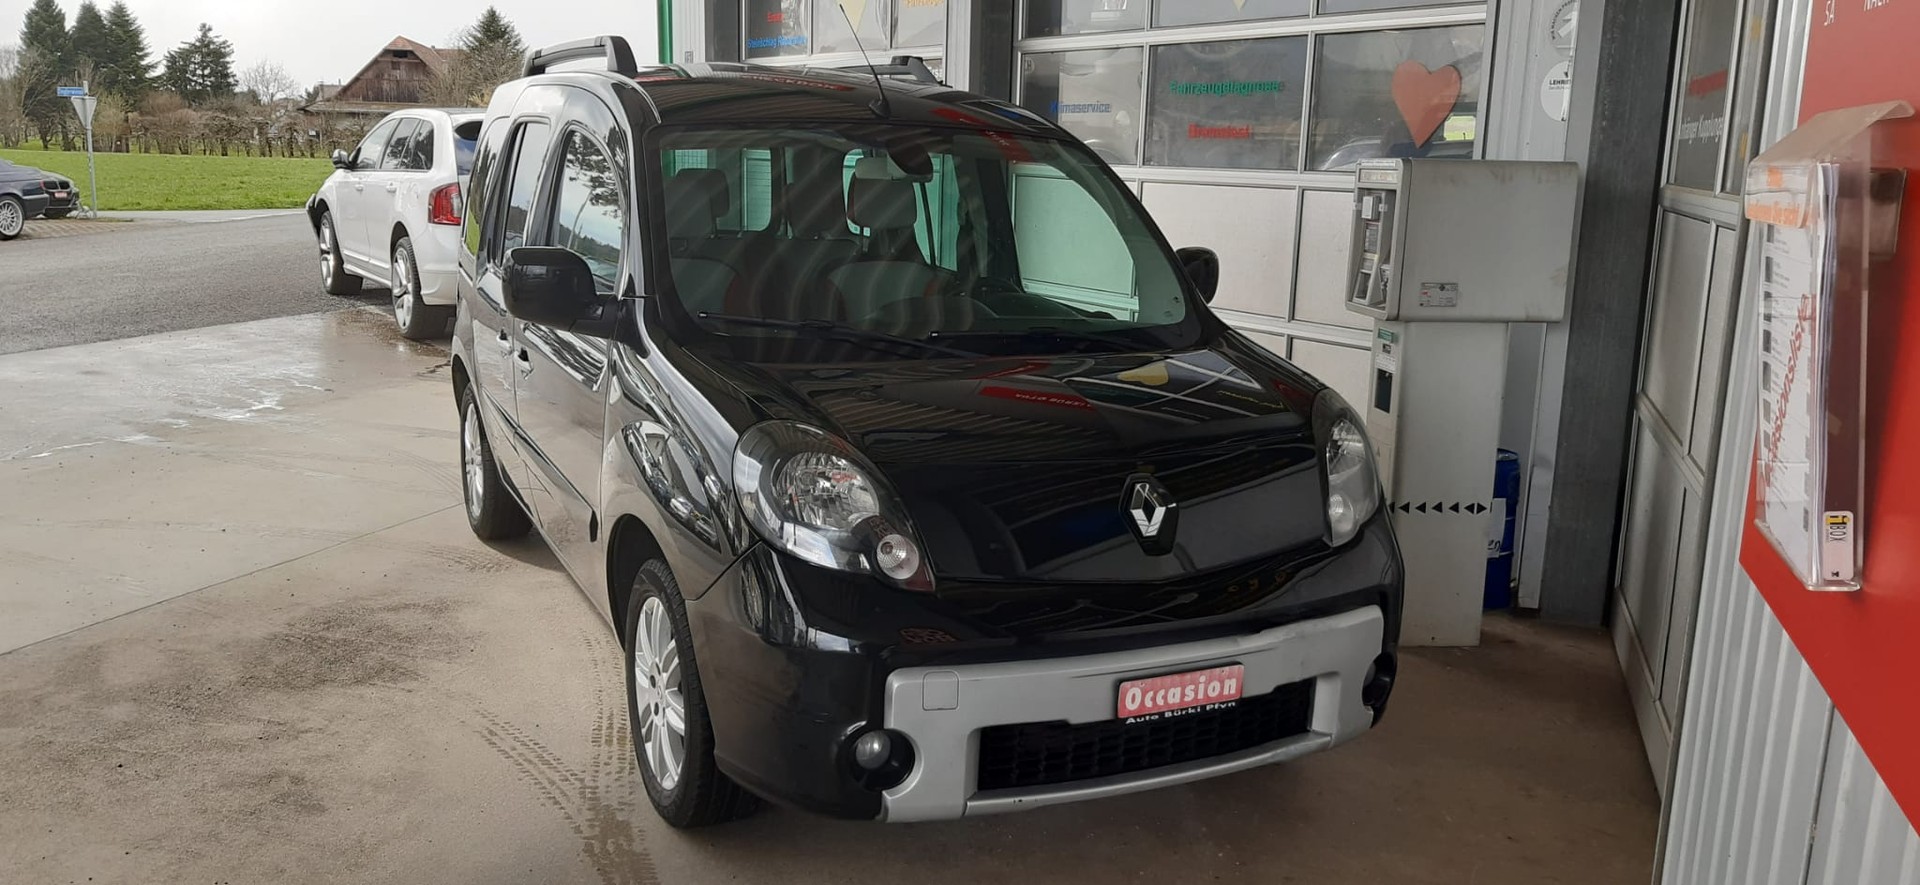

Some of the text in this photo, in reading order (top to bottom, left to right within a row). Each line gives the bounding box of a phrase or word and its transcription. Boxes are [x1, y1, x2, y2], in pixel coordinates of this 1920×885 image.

[1125, 675, 1237, 711] Occasion
[1125, 714, 1159, 724] Auto
[1164, 706, 1201, 718] Bürki
